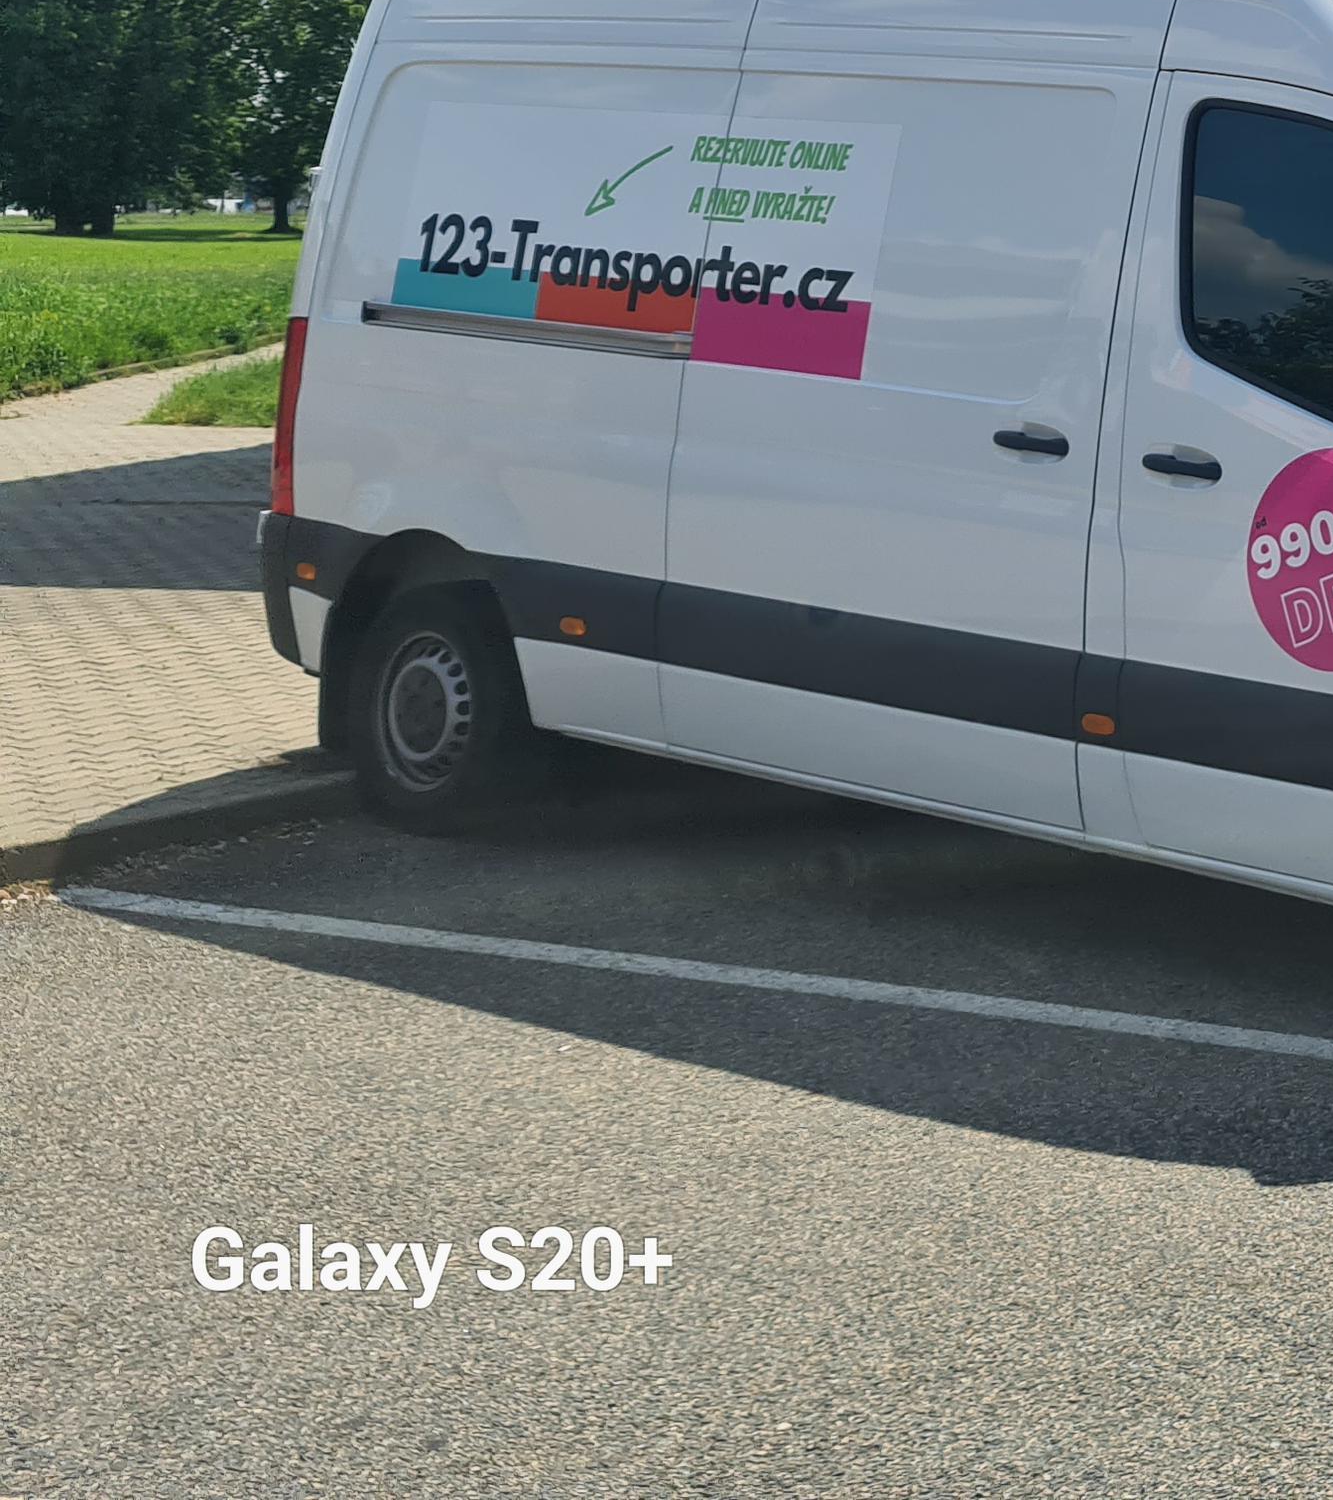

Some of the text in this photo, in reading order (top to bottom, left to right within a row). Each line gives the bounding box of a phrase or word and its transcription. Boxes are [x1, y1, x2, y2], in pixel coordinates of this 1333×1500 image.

[689, 135, 854, 172] REZERVUJTE ONLINE
[688, 185, 837, 225] A HNED VYRAŽTE!
[418, 213, 855, 313] 123-Transporter.cz
